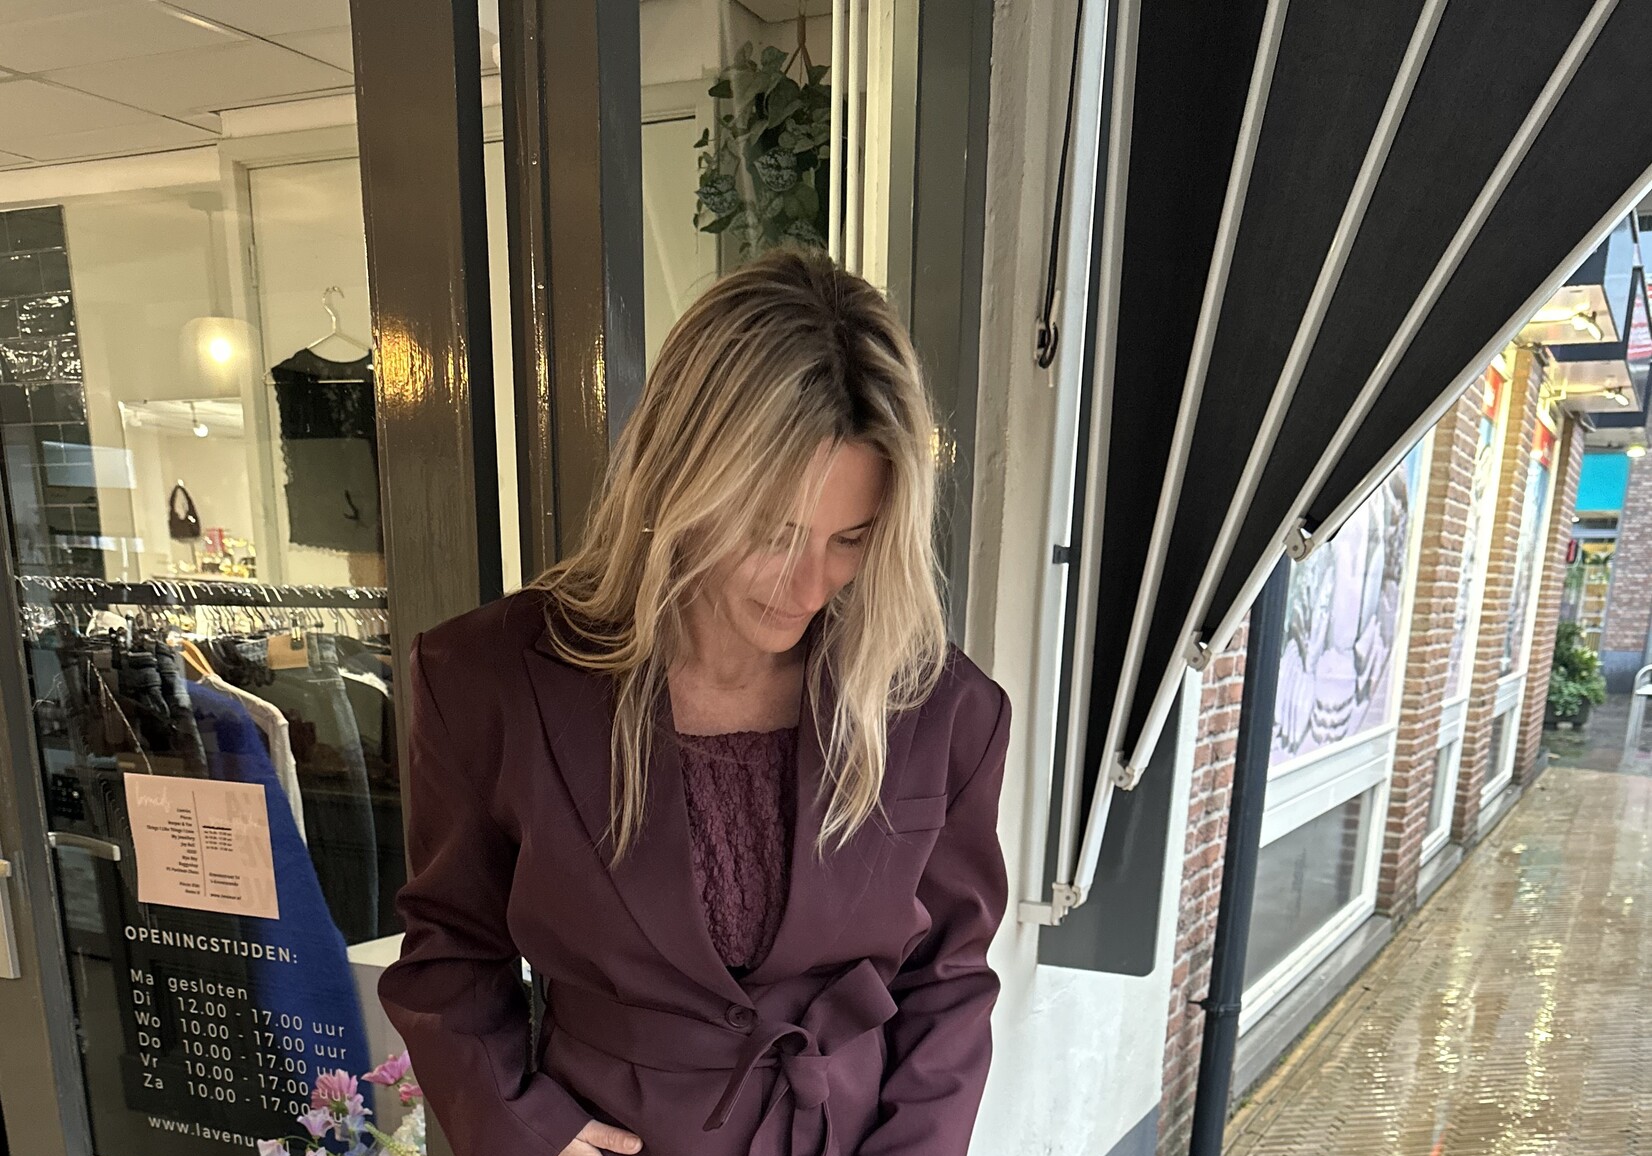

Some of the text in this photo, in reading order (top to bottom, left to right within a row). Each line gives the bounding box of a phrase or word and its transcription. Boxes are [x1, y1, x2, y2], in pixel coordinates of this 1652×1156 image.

[125, 925, 298, 964] OPENINGSTIJDEN:
[130, 968, 247, 1000] Ma gesloten
[133, 990, 151, 1005] Di
[178, 997, 227, 1018] 12.00
[251, 1008, 303, 1030] 17.00
[312, 1022, 345, 1037] uur
[134, 1010, 161, 1028] Wo
[180, 1018, 229, 1040] 10.00
[253, 1030, 305, 1053] 17.00
[314, 1044, 347, 1060] uur
[138, 1032, 161, 1048] Do
[183, 1039, 231, 1061] 10.00
[255, 1052, 307, 1074] 17.00
[140, 1052, 158, 1068] Vr
[185, 1060, 234, 1082] 10.00
[258, 1073, 309, 1096] 17.00
[143, 1073, 164, 1089] Za
[187, 1081, 236, 1103] 10.00
[260, 1095, 312, 1117] 17.00
